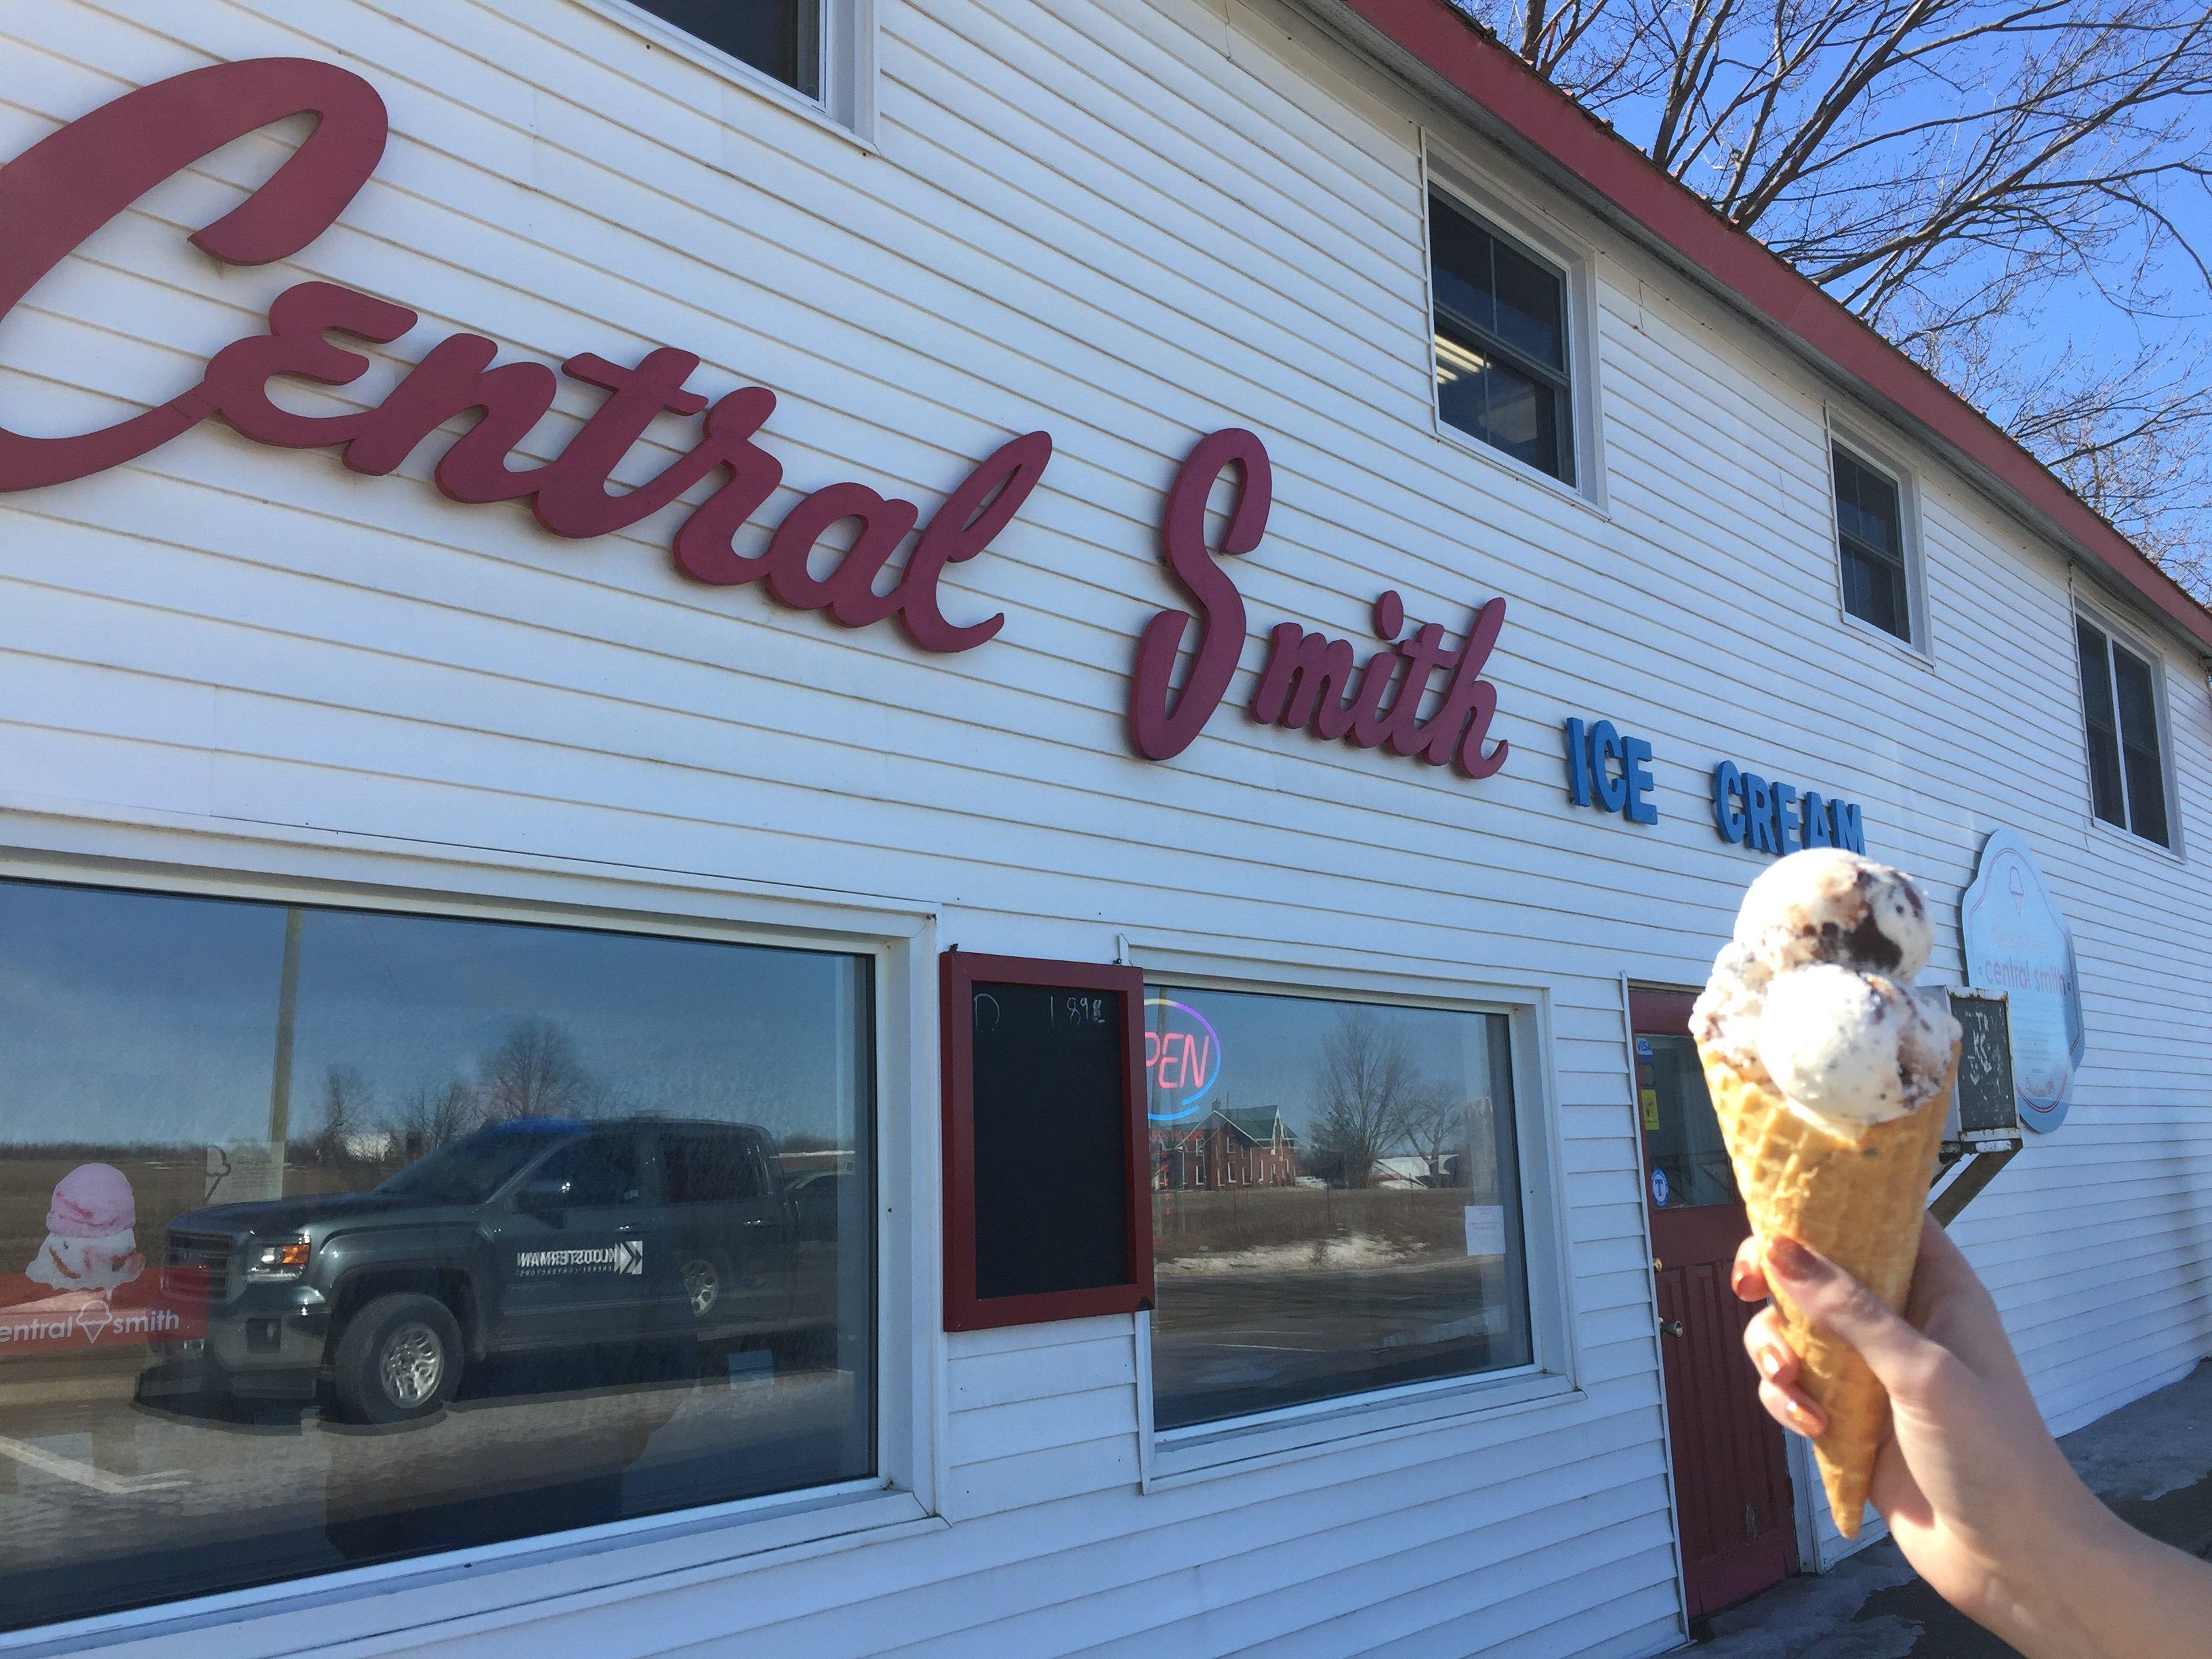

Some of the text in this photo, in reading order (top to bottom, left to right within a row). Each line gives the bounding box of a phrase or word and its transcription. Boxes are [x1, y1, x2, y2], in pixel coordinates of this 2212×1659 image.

[0, 57, 1509, 779] Central Smith
[1566, 716, 1866, 857] ICE CREAM
[1986, 957, 2067, 997] central smith
[1637, 1040, 1653, 1052] VISA
[112, 1309, 180, 1334] smith
